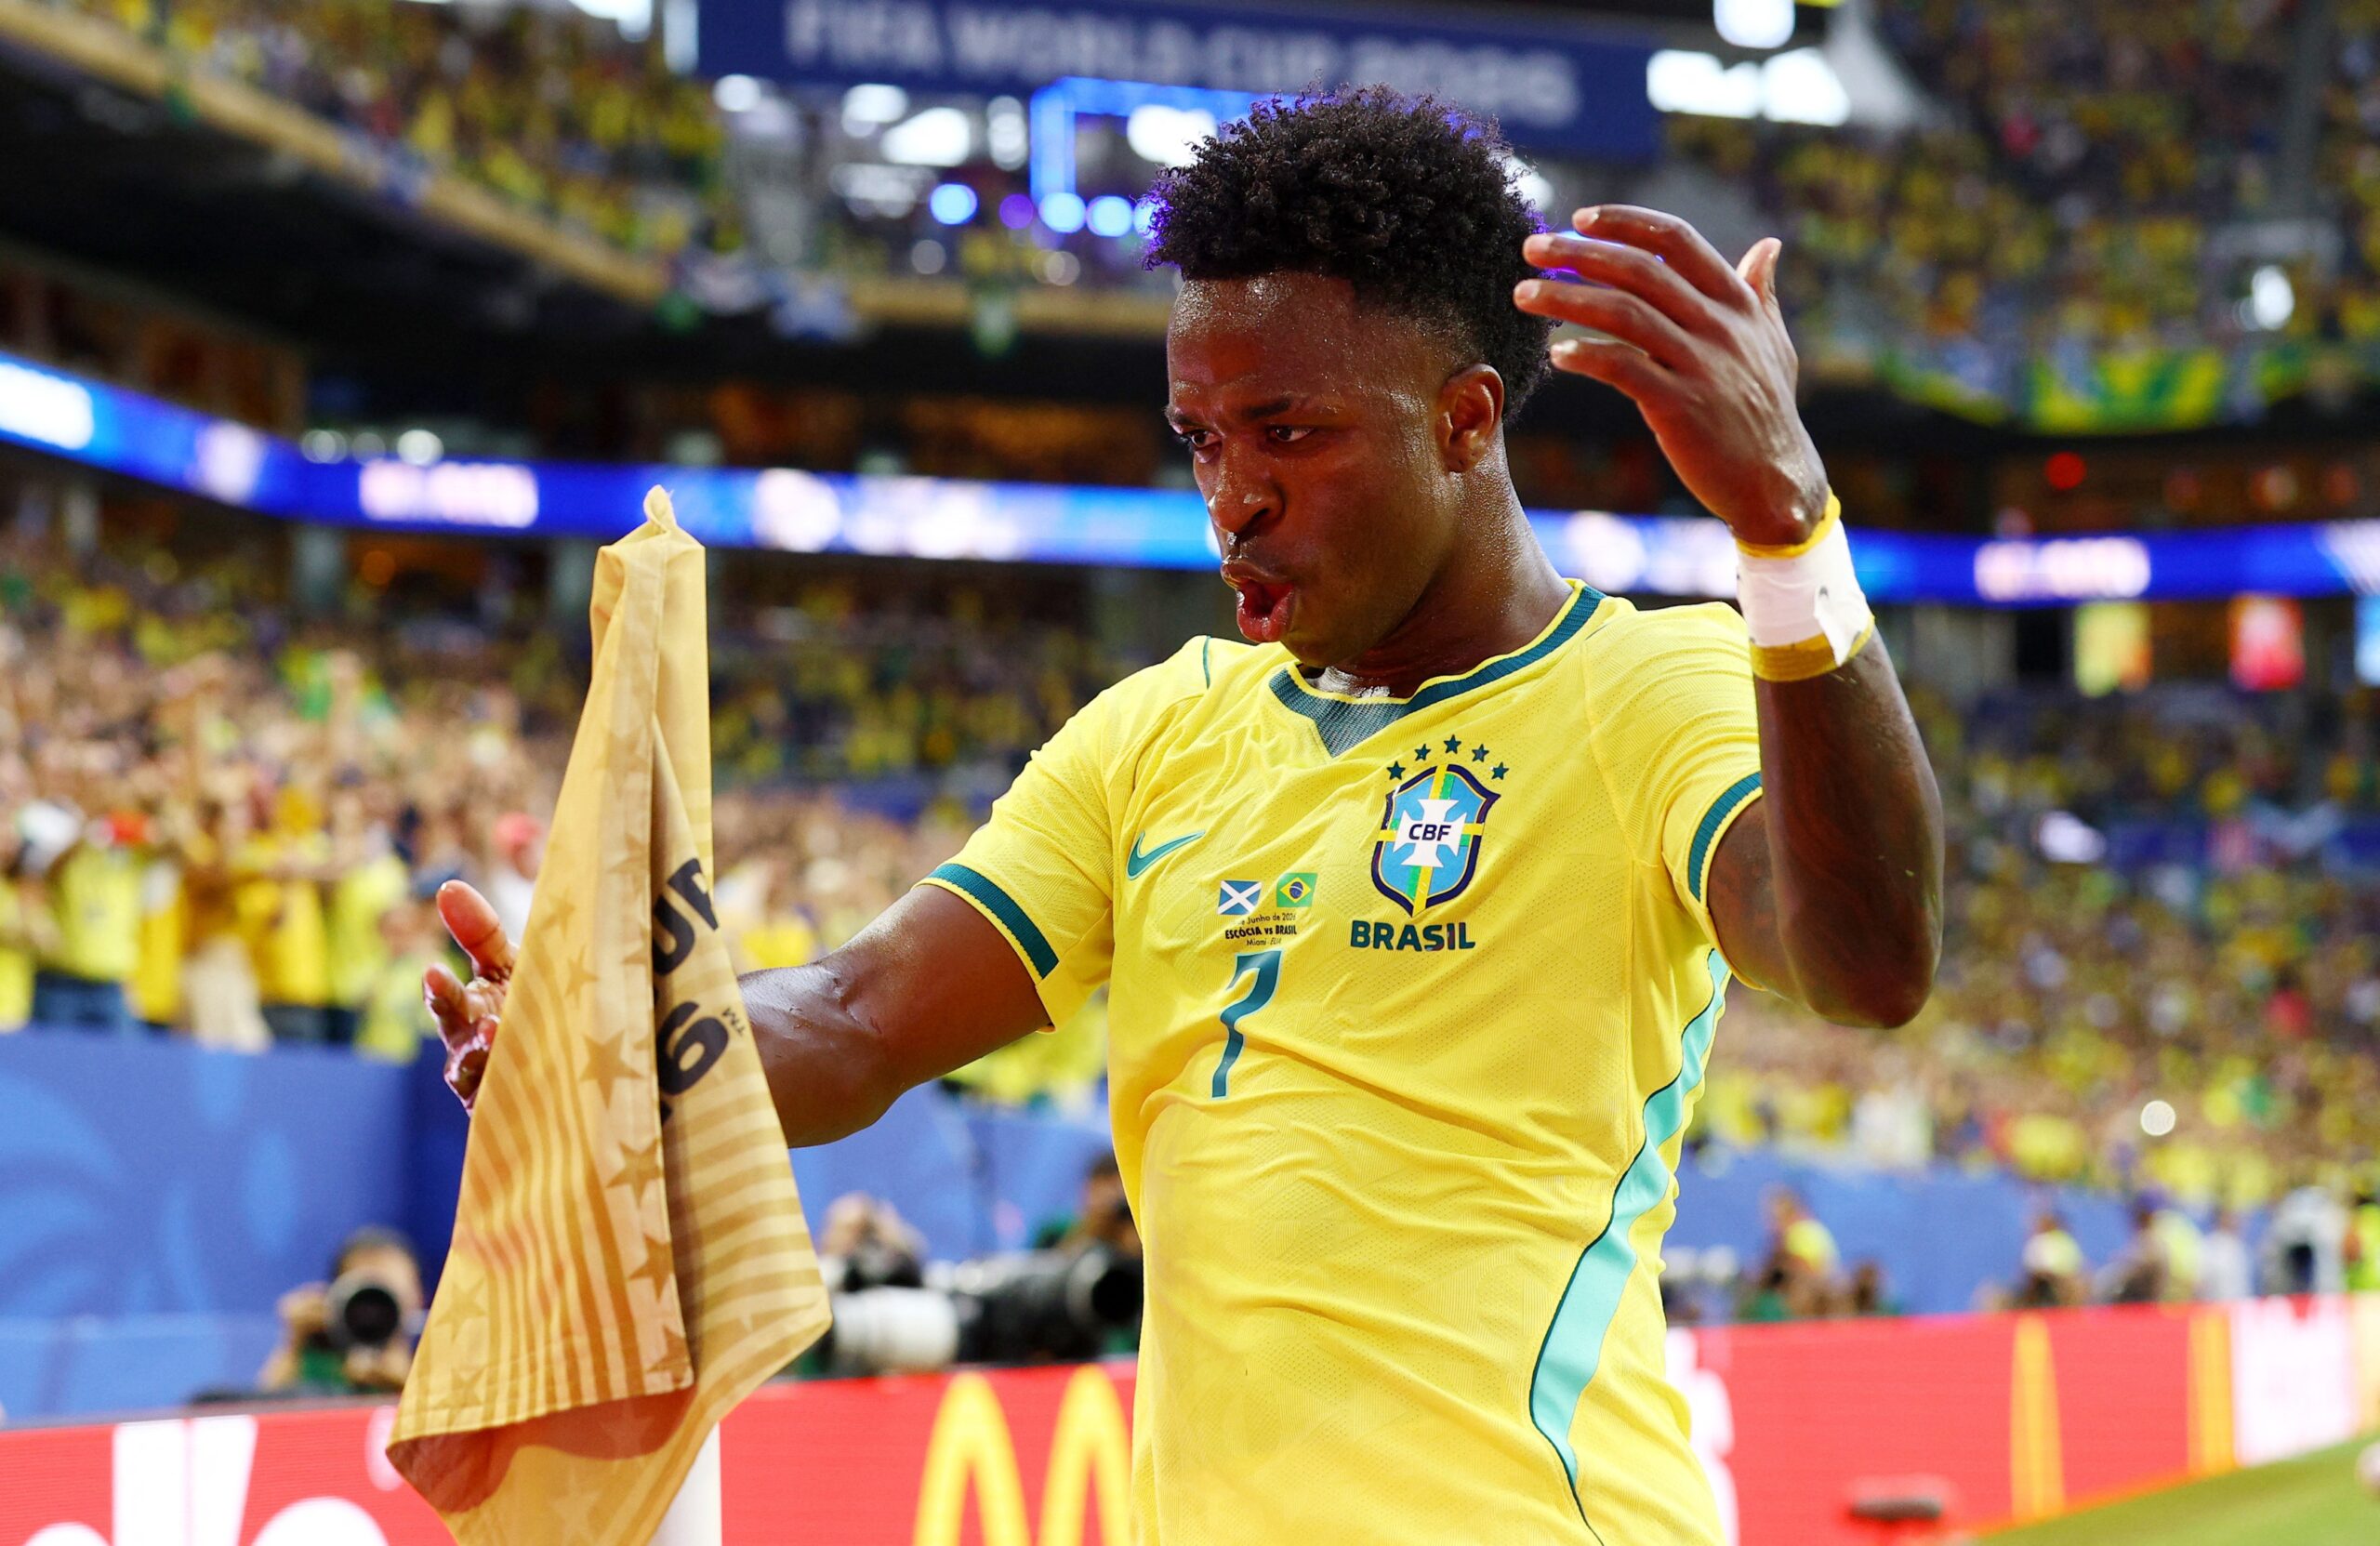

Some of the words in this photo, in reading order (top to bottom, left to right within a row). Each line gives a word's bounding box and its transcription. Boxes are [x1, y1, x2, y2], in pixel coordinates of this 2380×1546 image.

[784, 0, 943, 70] FIFA
[950, 5, 1201, 86] WORLD
[1207, 25, 1336, 95] CUP
[1408, 824, 1451, 841] CBF
[1224, 926, 1263, 939] ESCÓCIA
[1276, 924, 1297, 934] BRASIL
[1247, 914, 1271, 924] Junho
[1350, 919, 1476, 952] BRASIL
[1210, 948, 1283, 1100] 7
